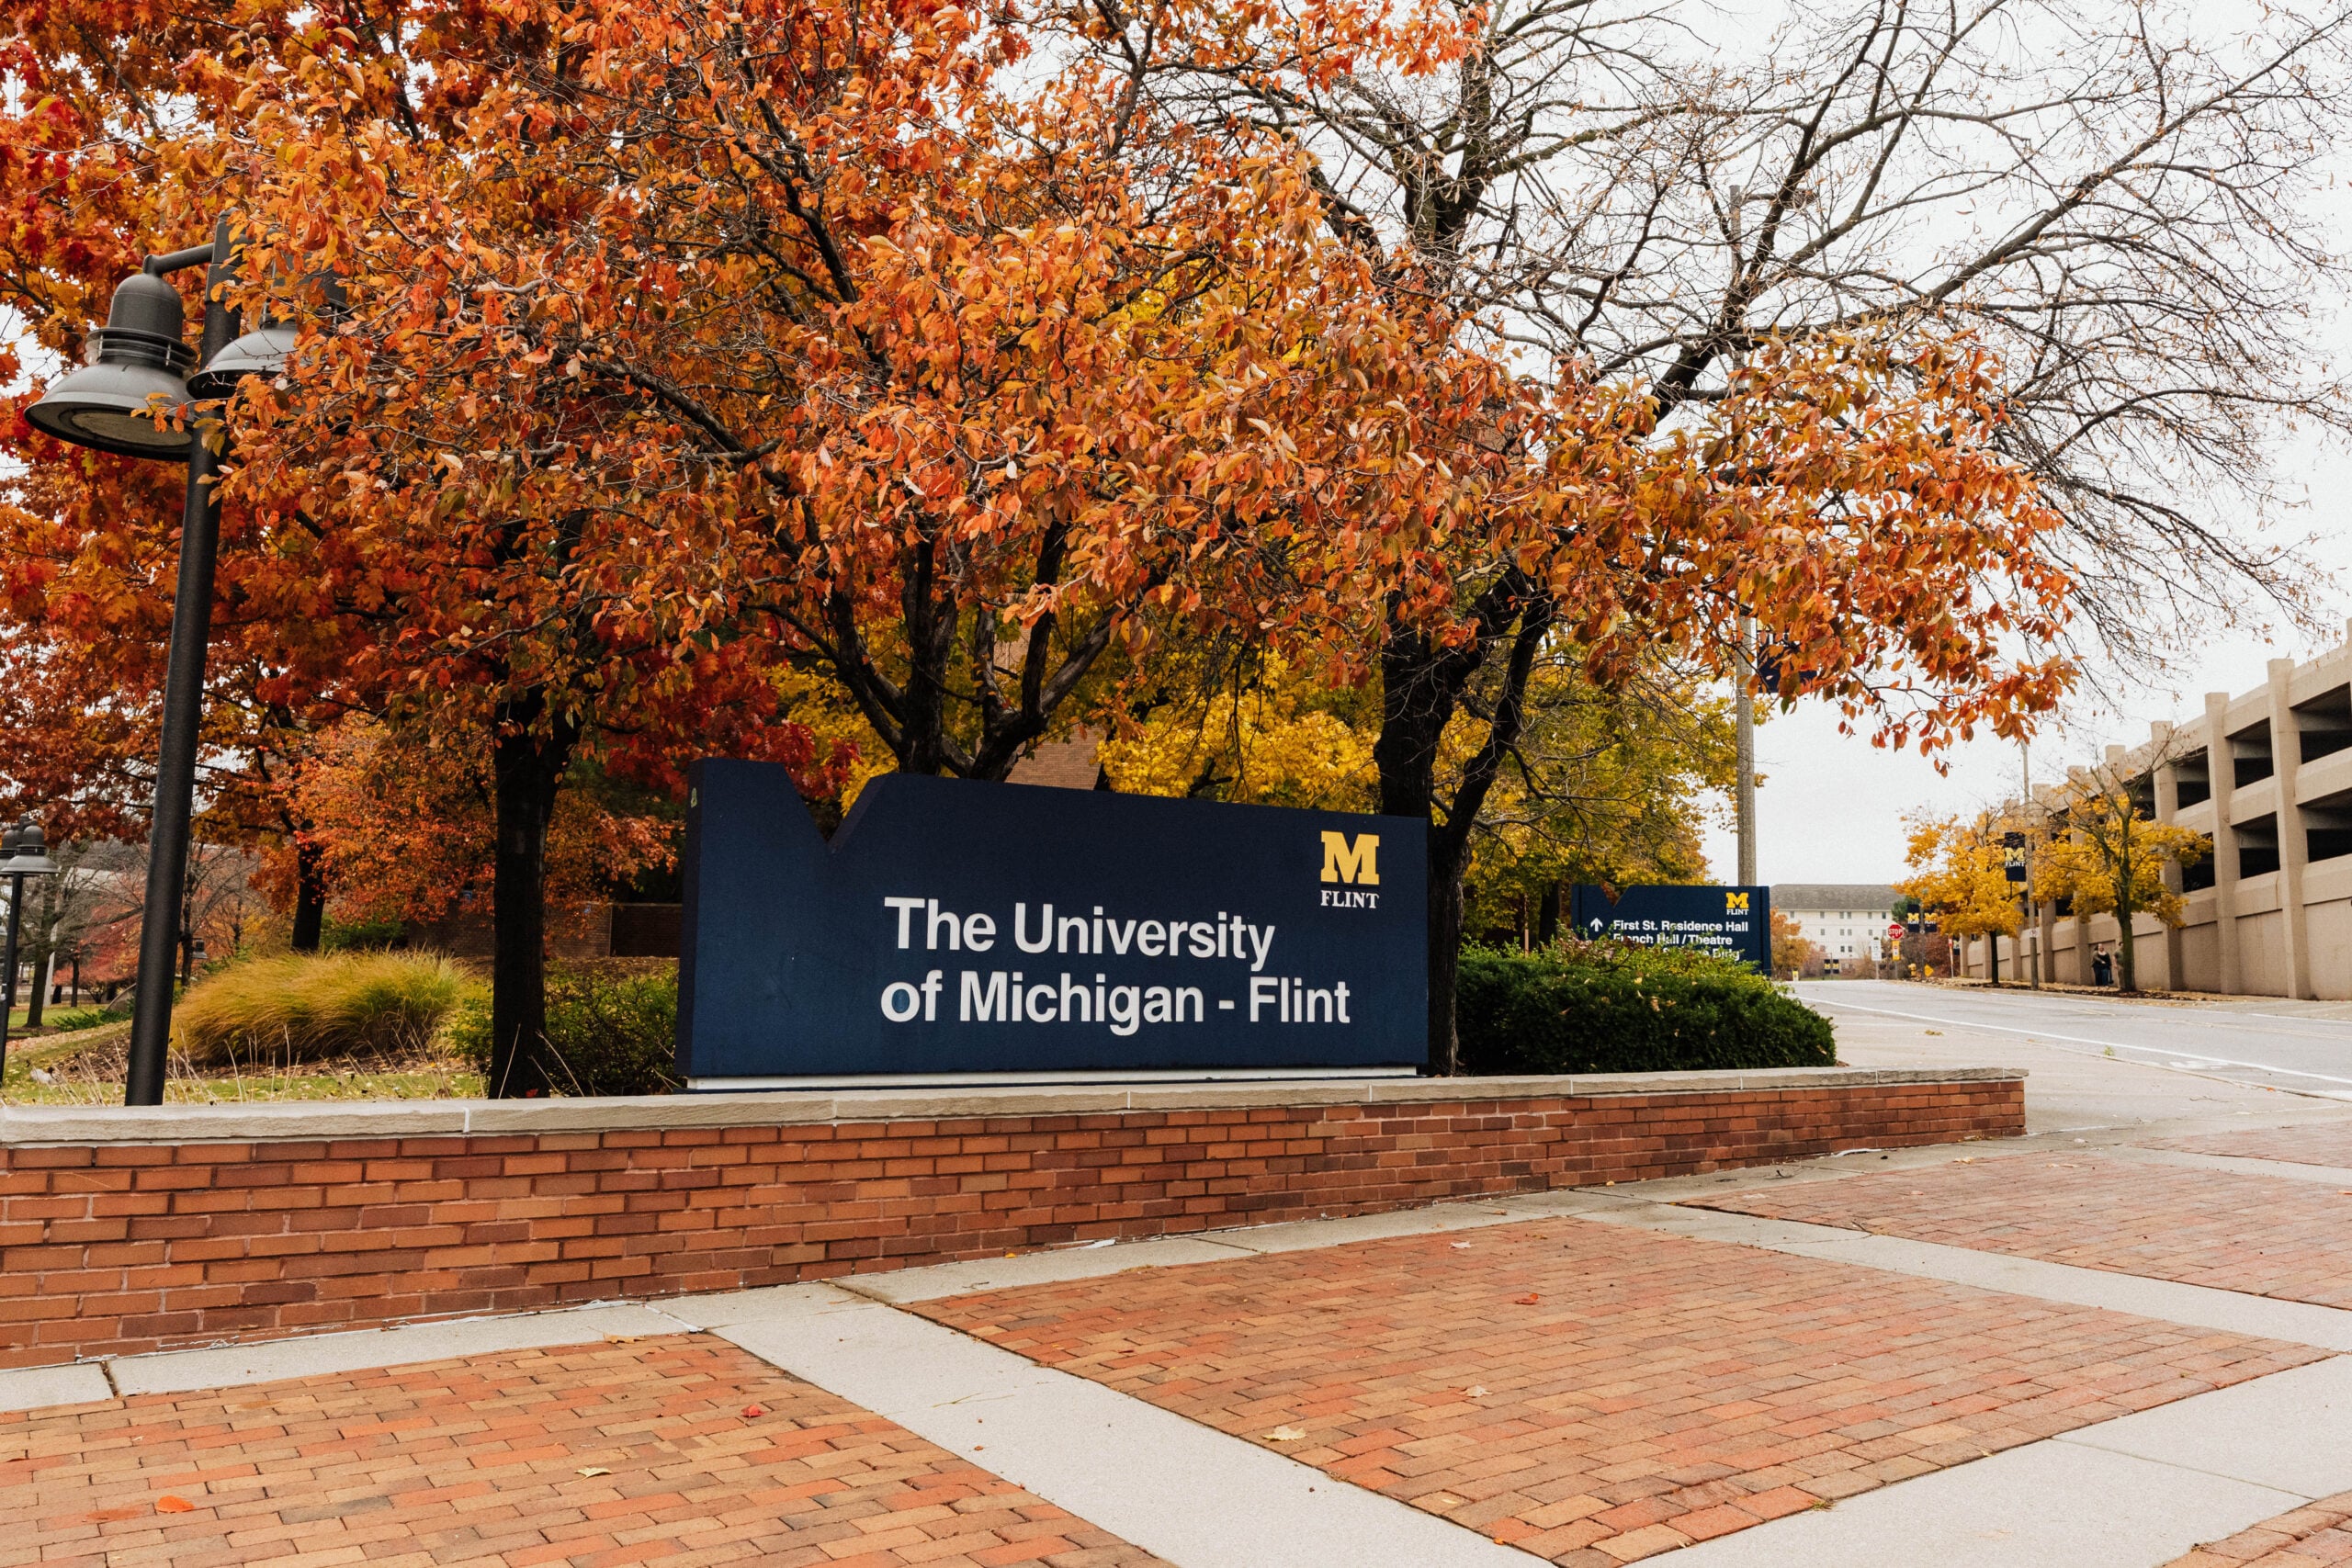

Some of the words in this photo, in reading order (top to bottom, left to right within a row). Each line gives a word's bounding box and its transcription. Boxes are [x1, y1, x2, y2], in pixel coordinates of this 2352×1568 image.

[1320, 830, 1380, 886] M
[2005, 847, 2025, 862] M
[1320, 889, 1380, 908] FLINT
[1725, 892, 1749, 908] M
[1613, 919, 1640, 931] First
[1642, 919, 1658, 931] St.
[1661, 920, 1723, 931] Residence
[1725, 921, 1748, 931] Hall
[884, 897, 997, 953] The
[1014, 902, 1276, 973] University
[1657, 934, 1679, 944] Hall
[1688, 934, 1733, 945] Theatre
[881, 969, 943, 1022] of
[960, 970, 1204, 1036] Michigan
[1250, 976, 1350, 1024] Flint
